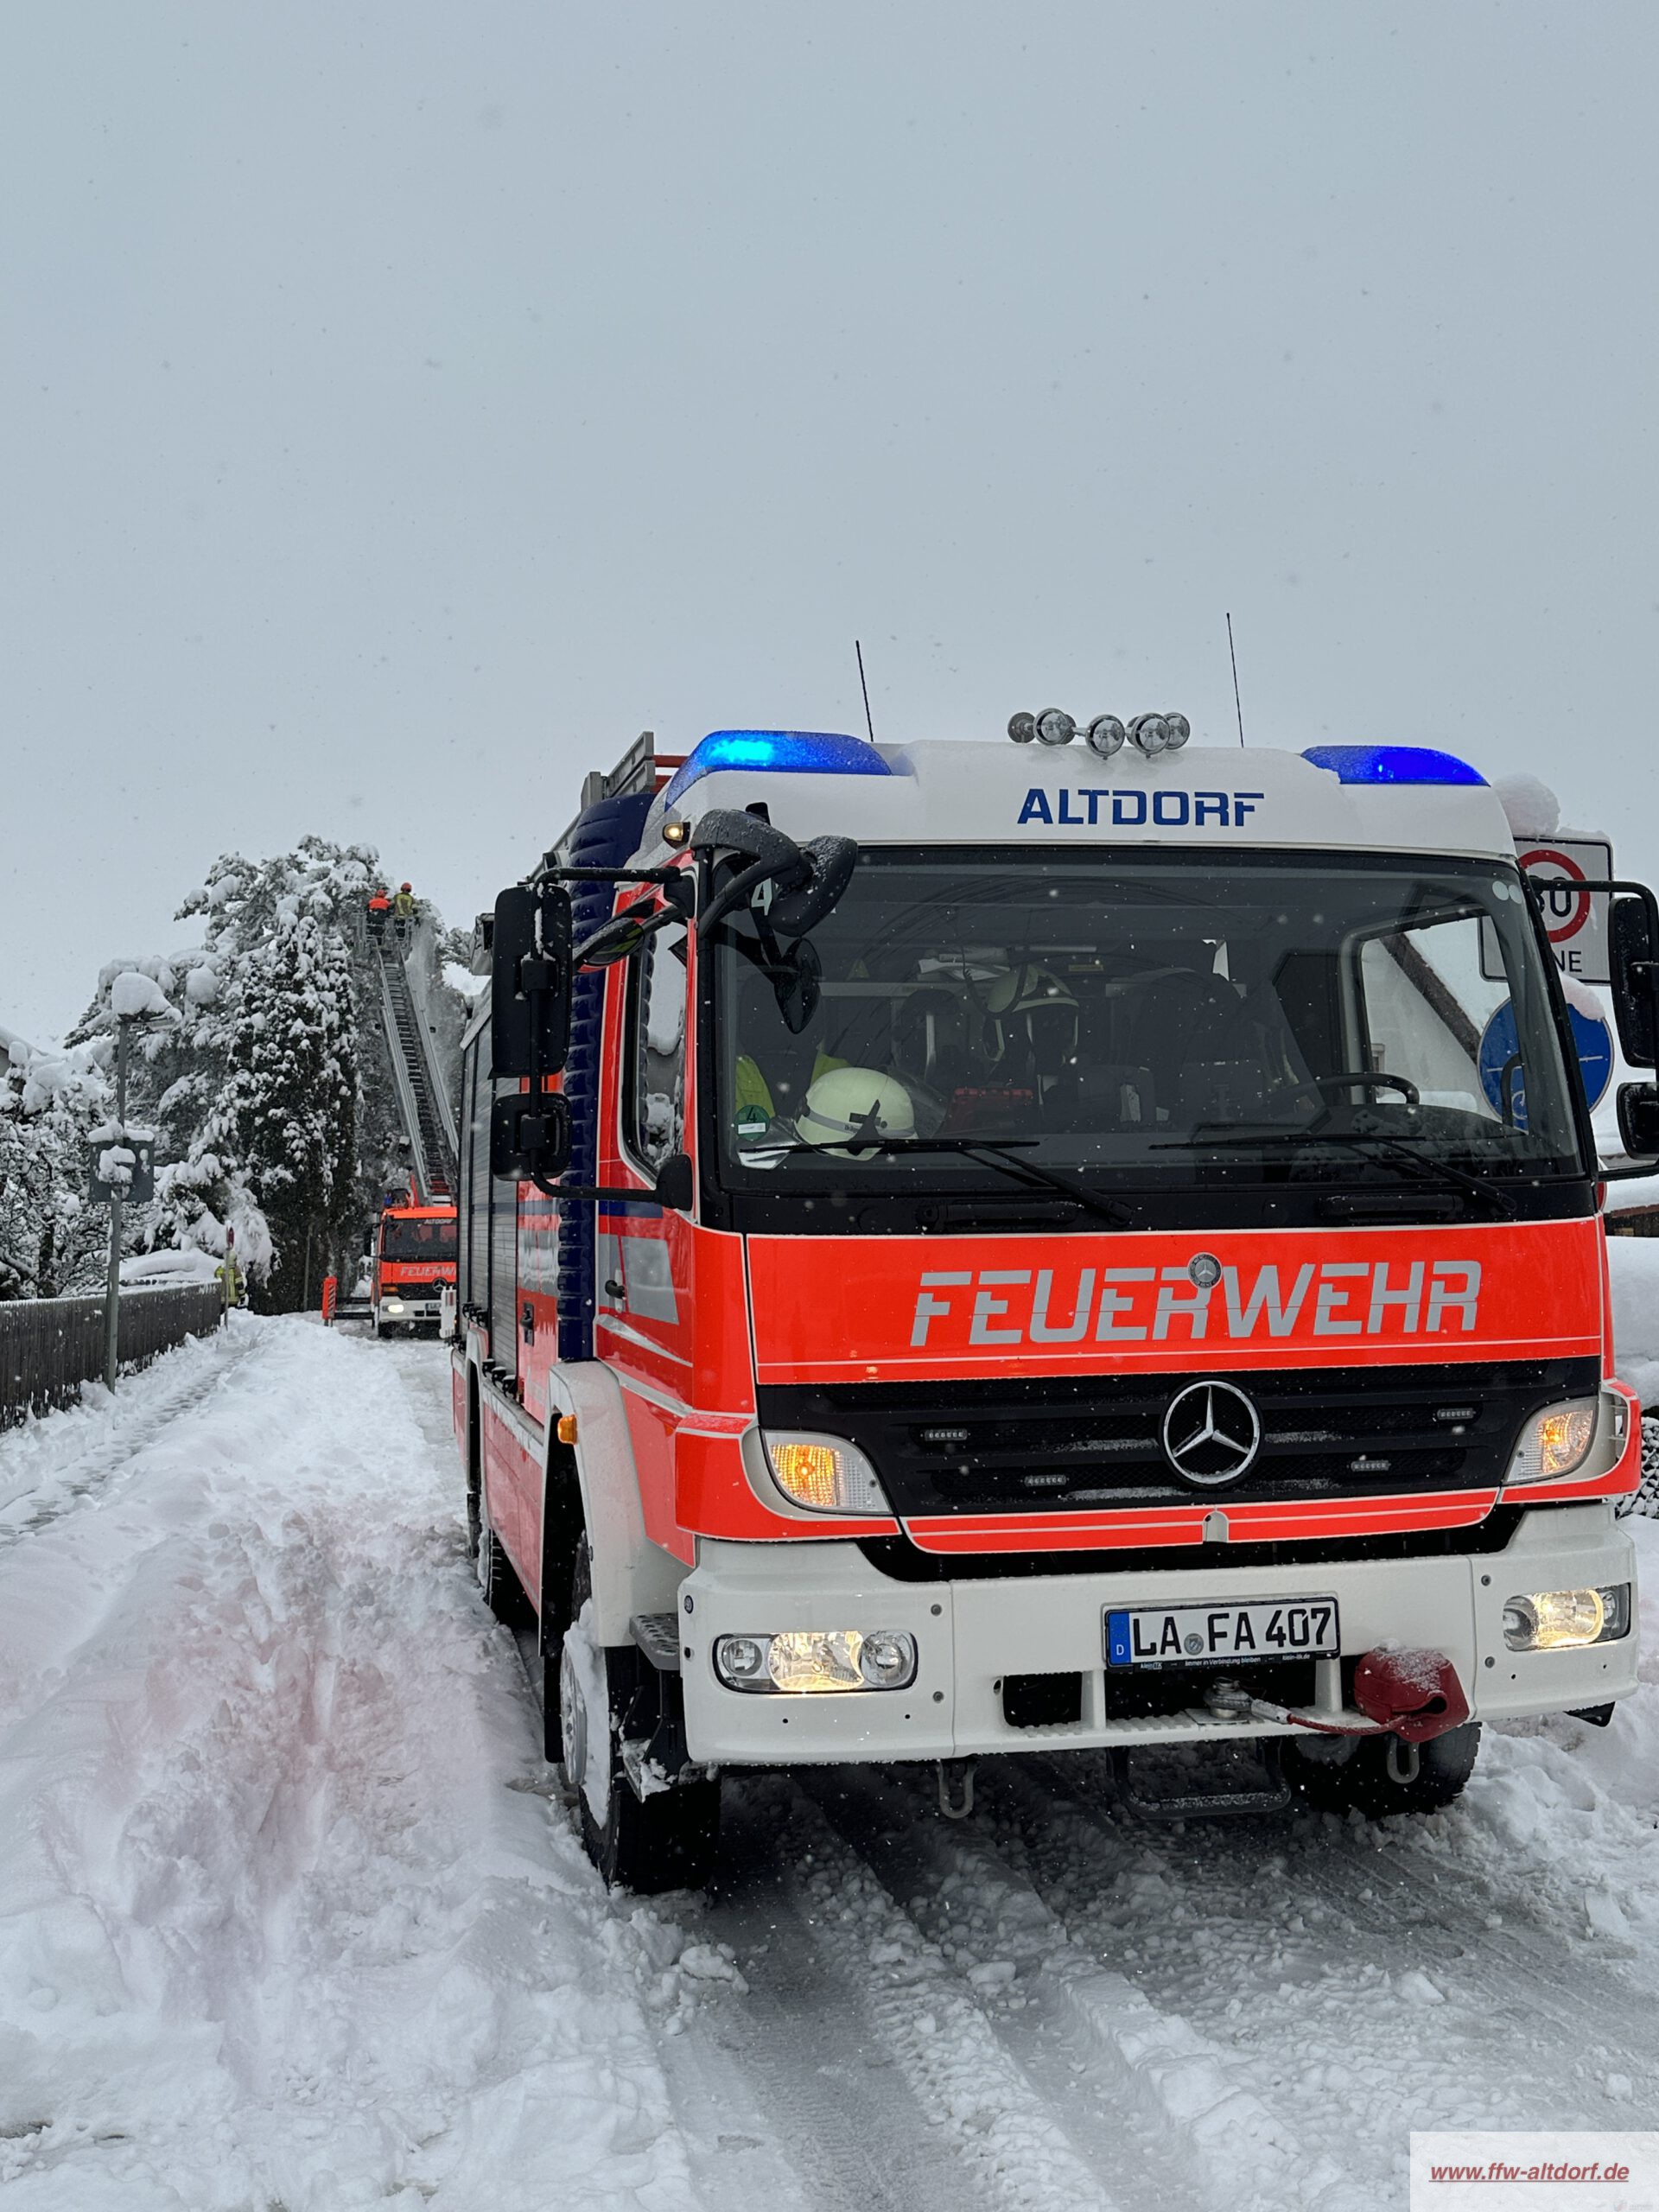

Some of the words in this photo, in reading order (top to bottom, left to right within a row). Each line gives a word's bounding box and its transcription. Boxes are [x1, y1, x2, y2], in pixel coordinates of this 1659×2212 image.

[1016, 788, 1265, 827] ALTDORF
[1554, 950, 1583, 973] NE
[400, 1266, 456, 1276] FEUERW
[910, 1260, 1483, 1347] FEUERWEHR
[1133, 1616, 1182, 1656] LA
[1207, 1611, 1256, 1652] FA
[1265, 1606, 1332, 1648] 407
[1116, 1643, 1125, 1656] D
